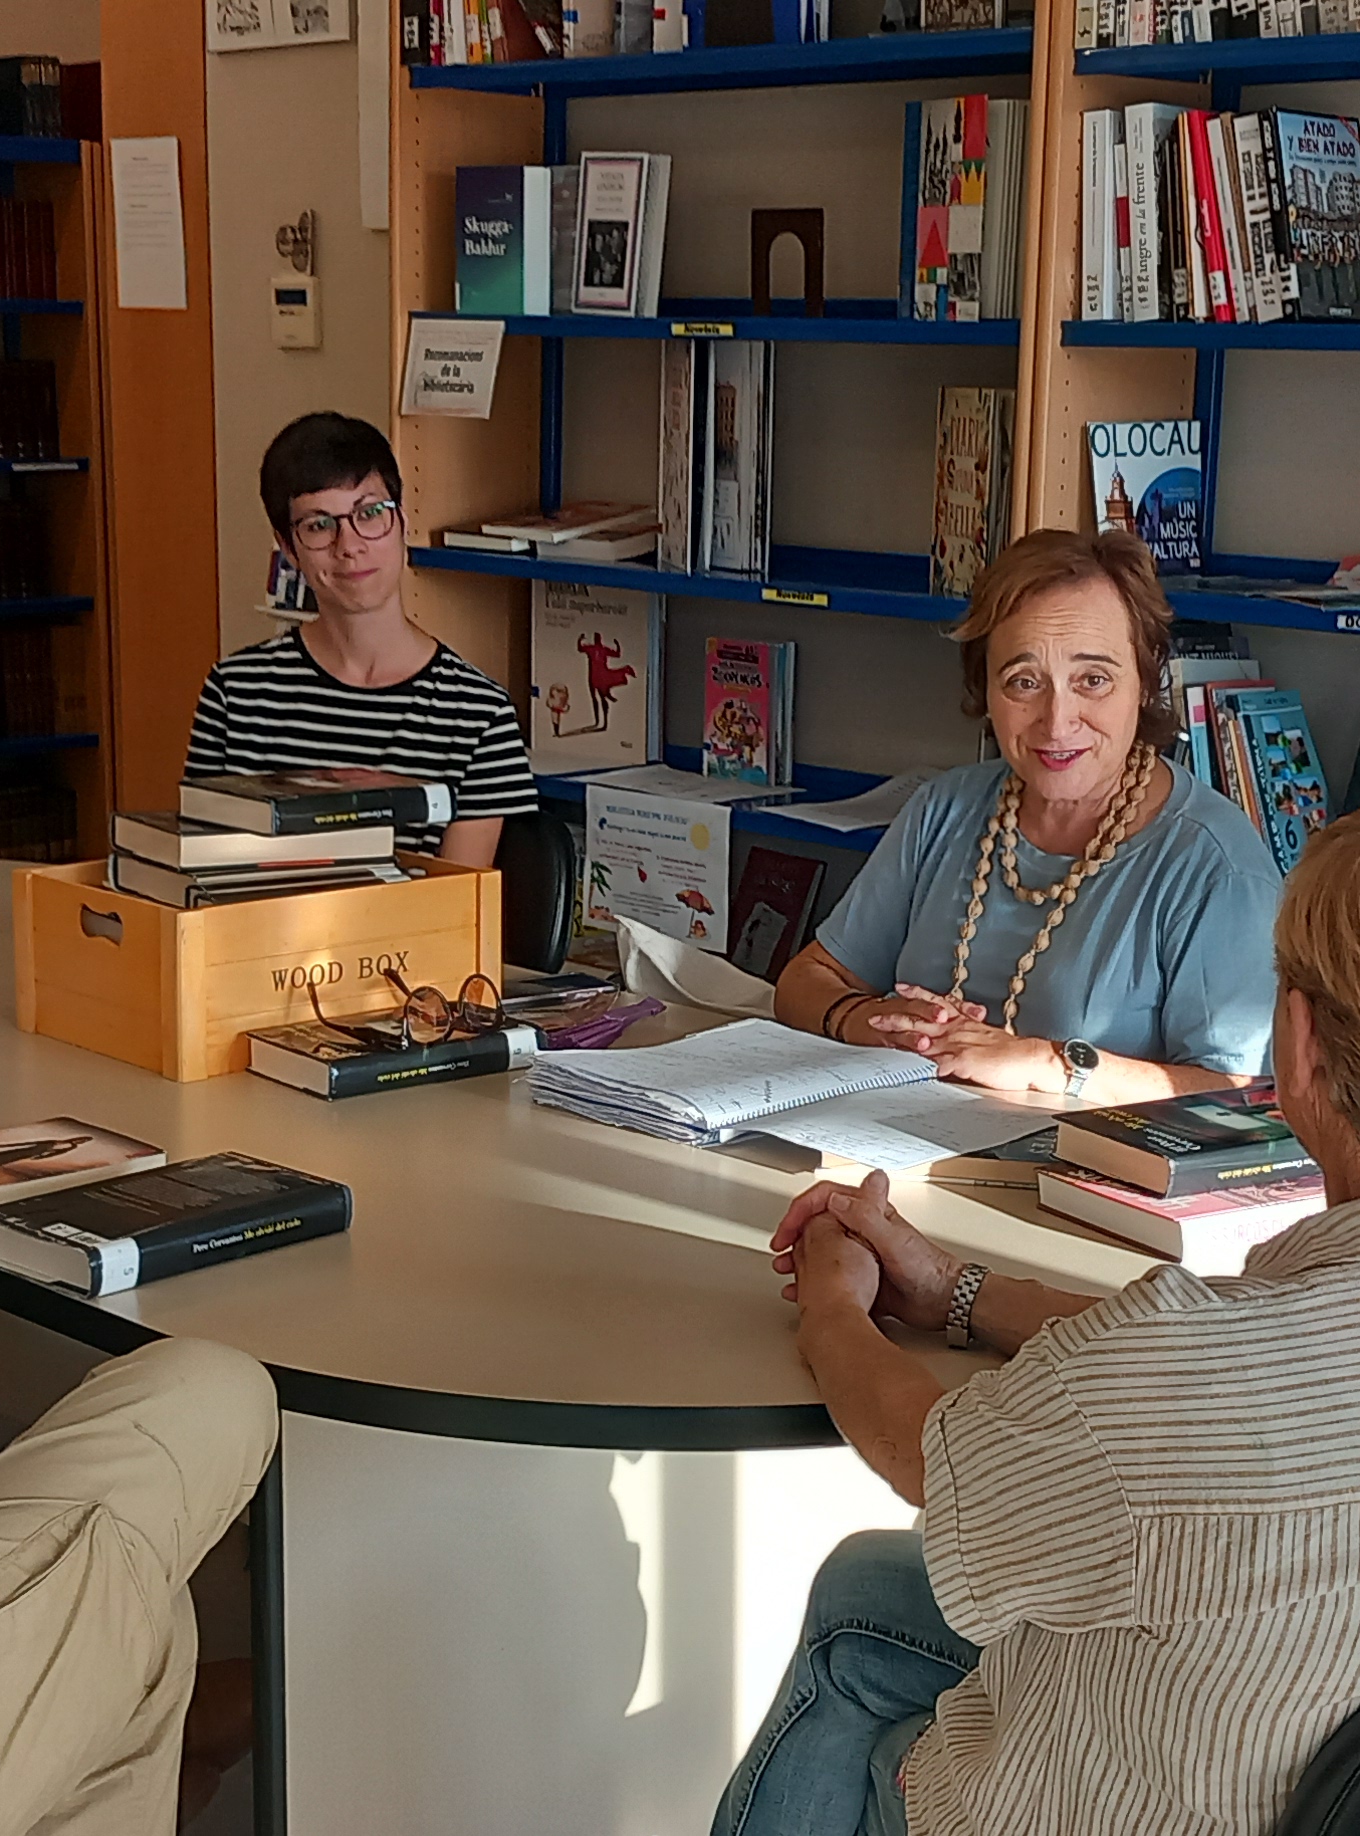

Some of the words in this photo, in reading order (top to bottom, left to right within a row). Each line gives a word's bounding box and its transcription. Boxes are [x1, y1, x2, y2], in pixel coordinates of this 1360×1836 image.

[1304, 120, 1336, 138] ATADO
[1287, 135, 1294, 151] Y
[1298, 137, 1319, 153] BIEN
[1323, 140, 1356, 158] ATADO
[1132, 162, 1146, 209] frente
[441, 363, 451, 377] de
[452, 364, 461, 378] la
[1090, 420, 1201, 458] OLOCAU
[1177, 500, 1196, 519] UN
[1150, 539, 1200, 560] 'ALTURA
[1284, 819, 1299, 850] 6
[271, 960, 343, 992] WOOD
[357, 951, 410, 980] BOX
[192, 1242, 209, 1254] Pere
[209, 1233, 244, 1249] Cervantes
[244, 1229, 255, 1240] Me
